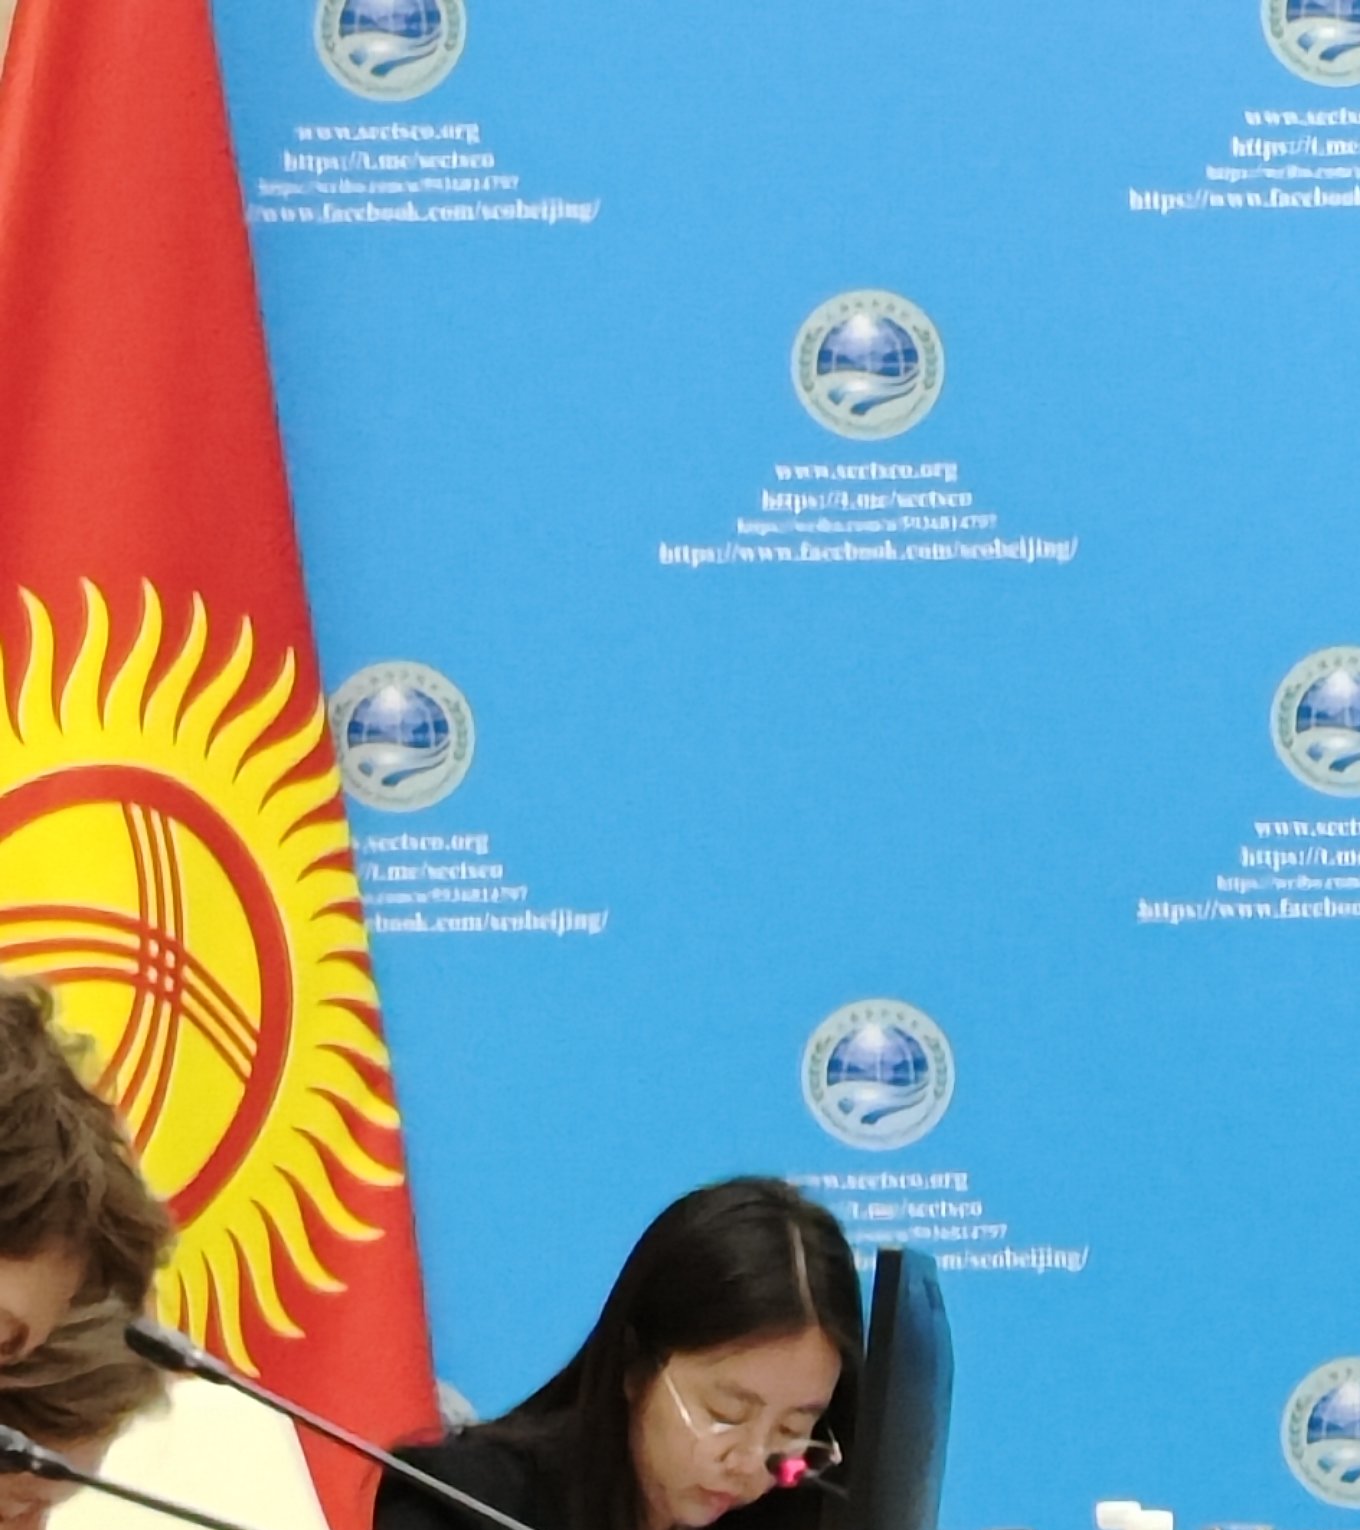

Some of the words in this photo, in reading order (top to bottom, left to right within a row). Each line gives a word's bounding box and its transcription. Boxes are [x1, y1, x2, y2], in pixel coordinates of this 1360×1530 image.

[293, 123, 483, 146] www.sectsco.org
[774, 462, 961, 484] www.sectsco.org
[657, 536, 1081, 571] https://www.facebook.com/scobeijing/
